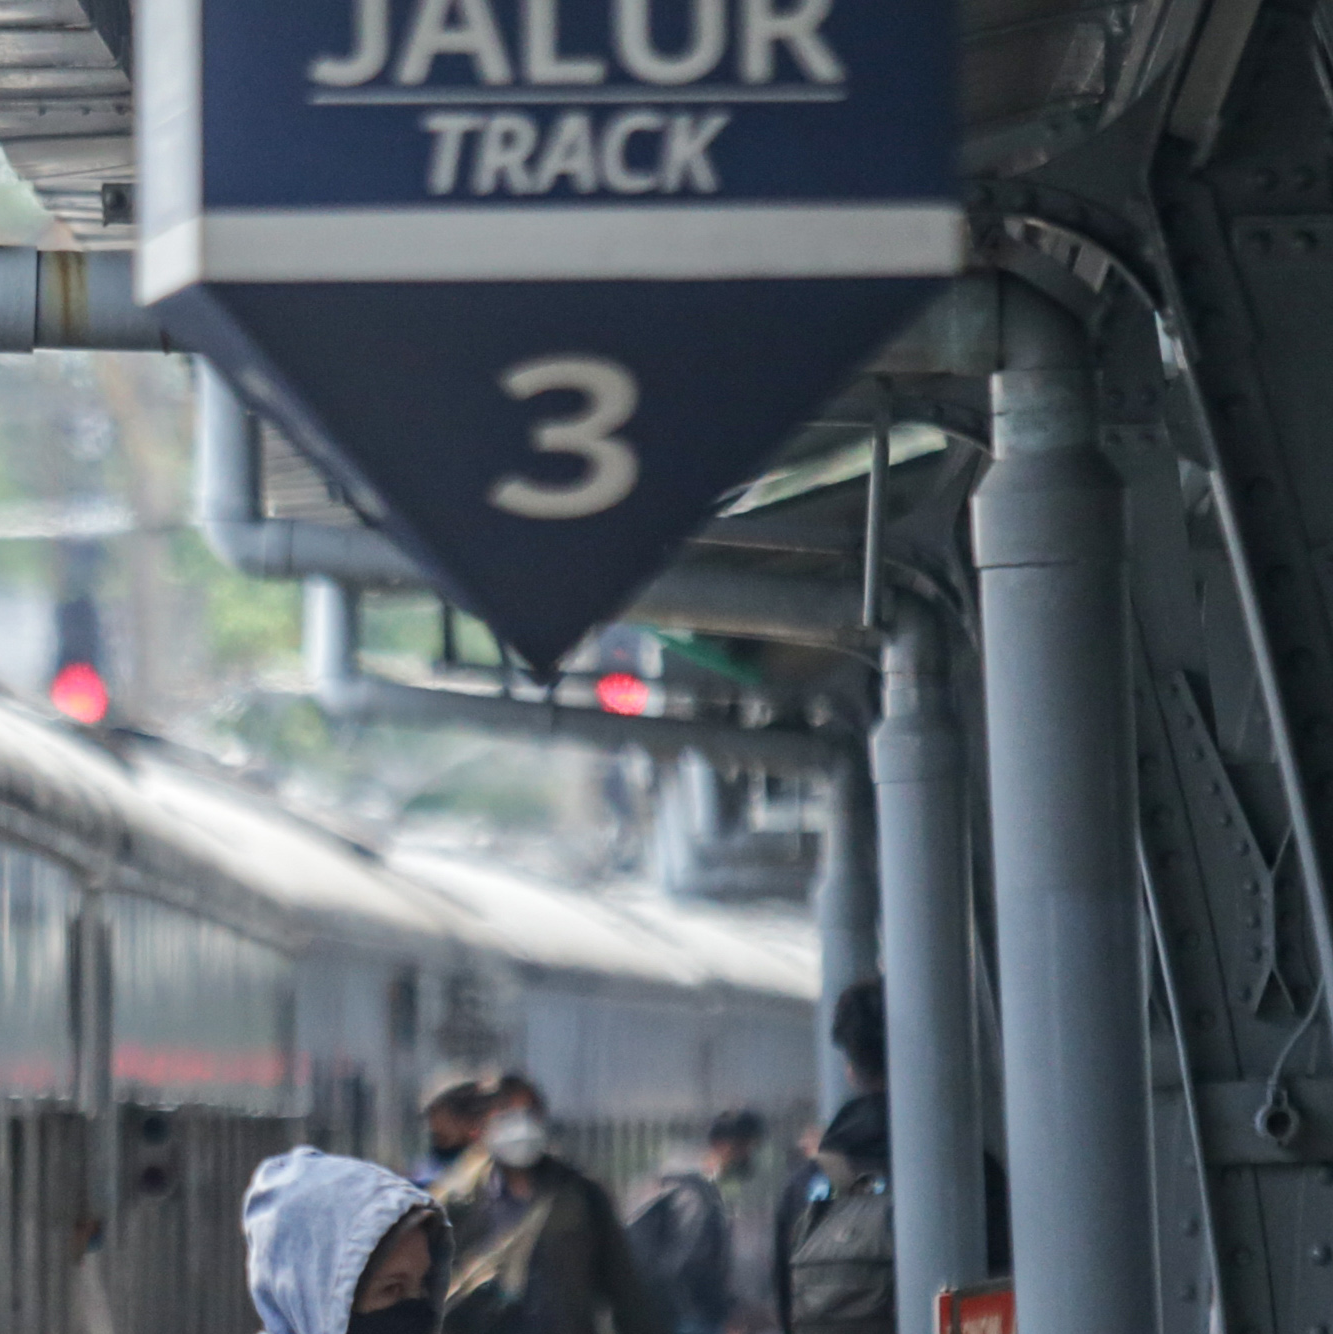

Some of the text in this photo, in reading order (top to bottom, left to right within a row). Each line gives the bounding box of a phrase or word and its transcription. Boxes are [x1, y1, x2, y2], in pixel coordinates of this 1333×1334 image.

[309, 0, 845, 86] JALUR
[423, 111, 731, 195] TRACK
[493, 355, 638, 520] 3
